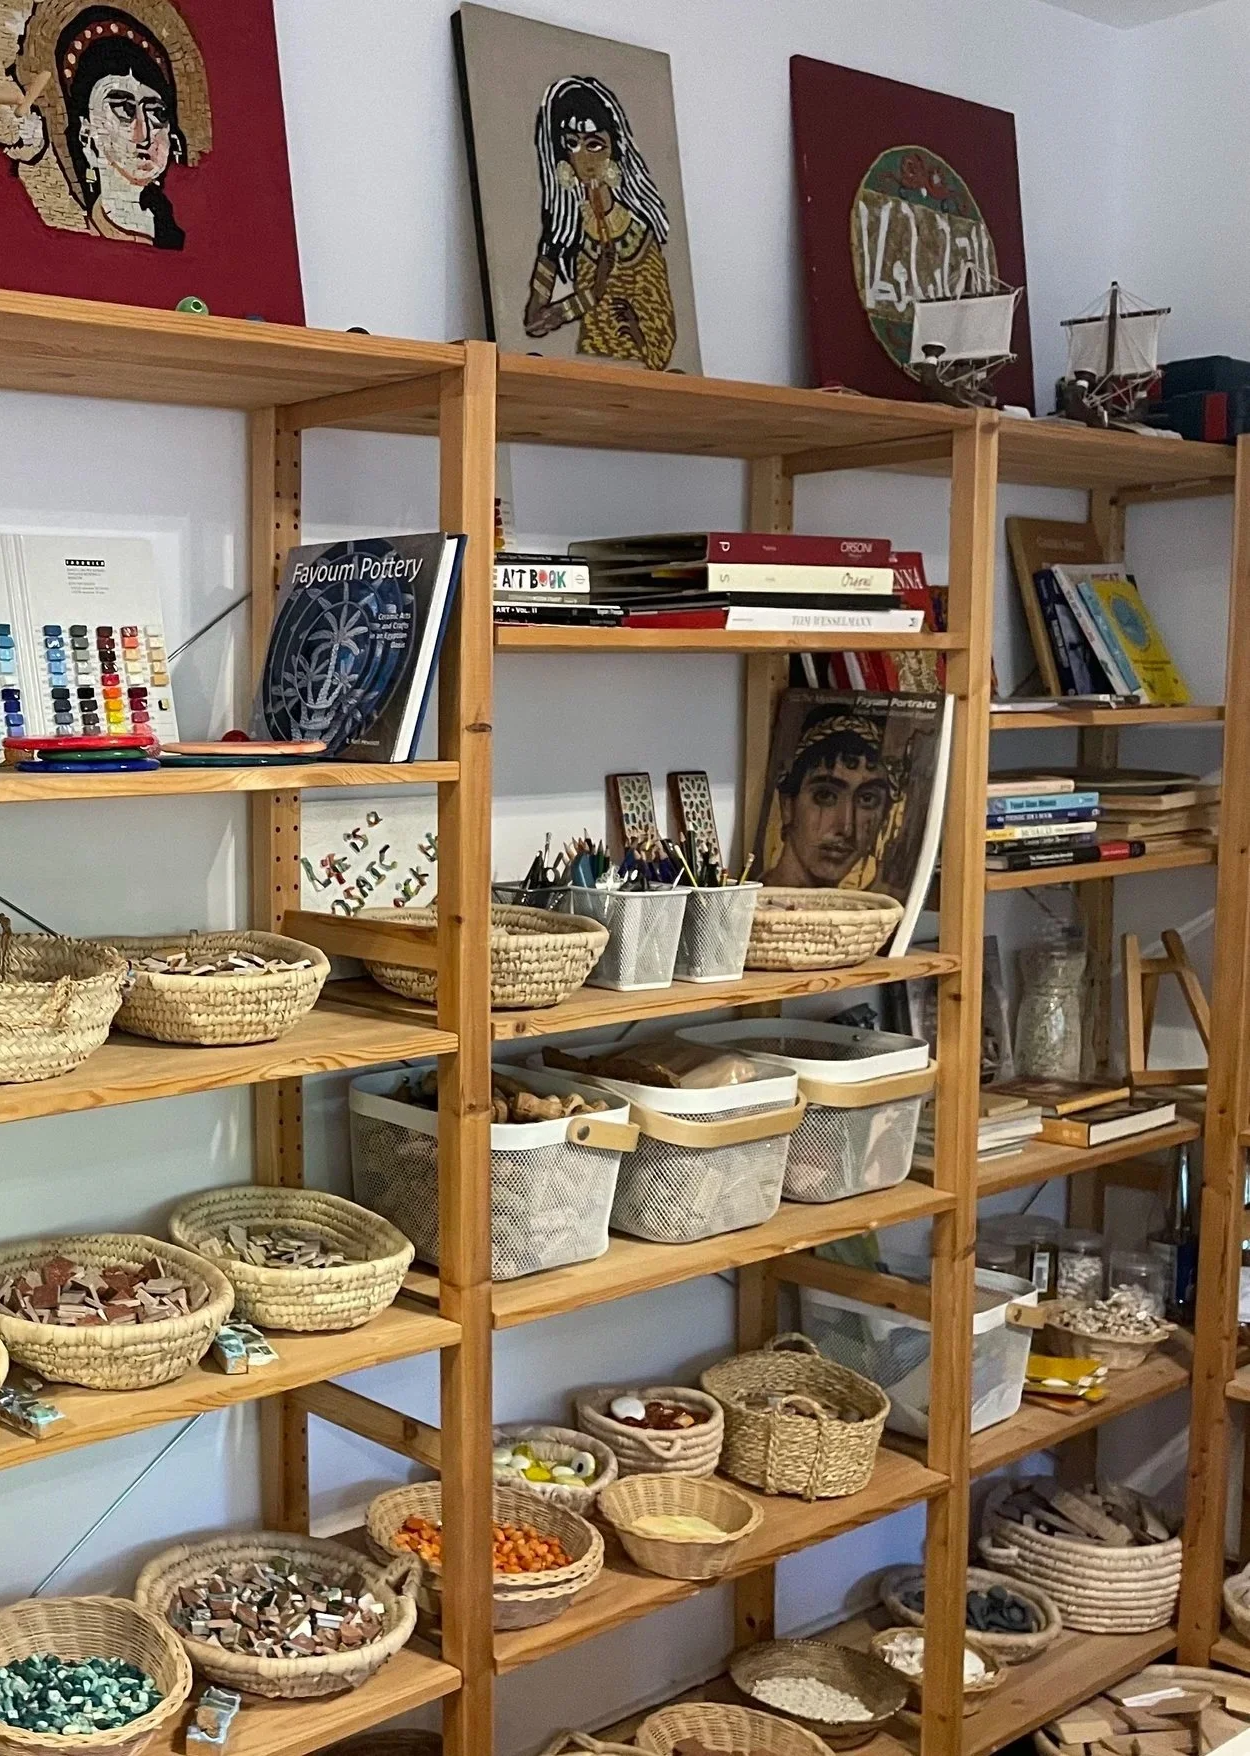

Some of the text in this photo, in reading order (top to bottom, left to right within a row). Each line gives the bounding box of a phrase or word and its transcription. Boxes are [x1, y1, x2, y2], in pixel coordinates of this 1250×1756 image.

[840, 541, 873, 553] ORSONI
[291, 557, 424, 588] Fayoum Pottery
[529, 568, 567, 589] BOOK
[892, 566, 924, 590] NNA
[890, 697, 937, 710] Portraits
[330, 844, 398, 916] OSAIC
